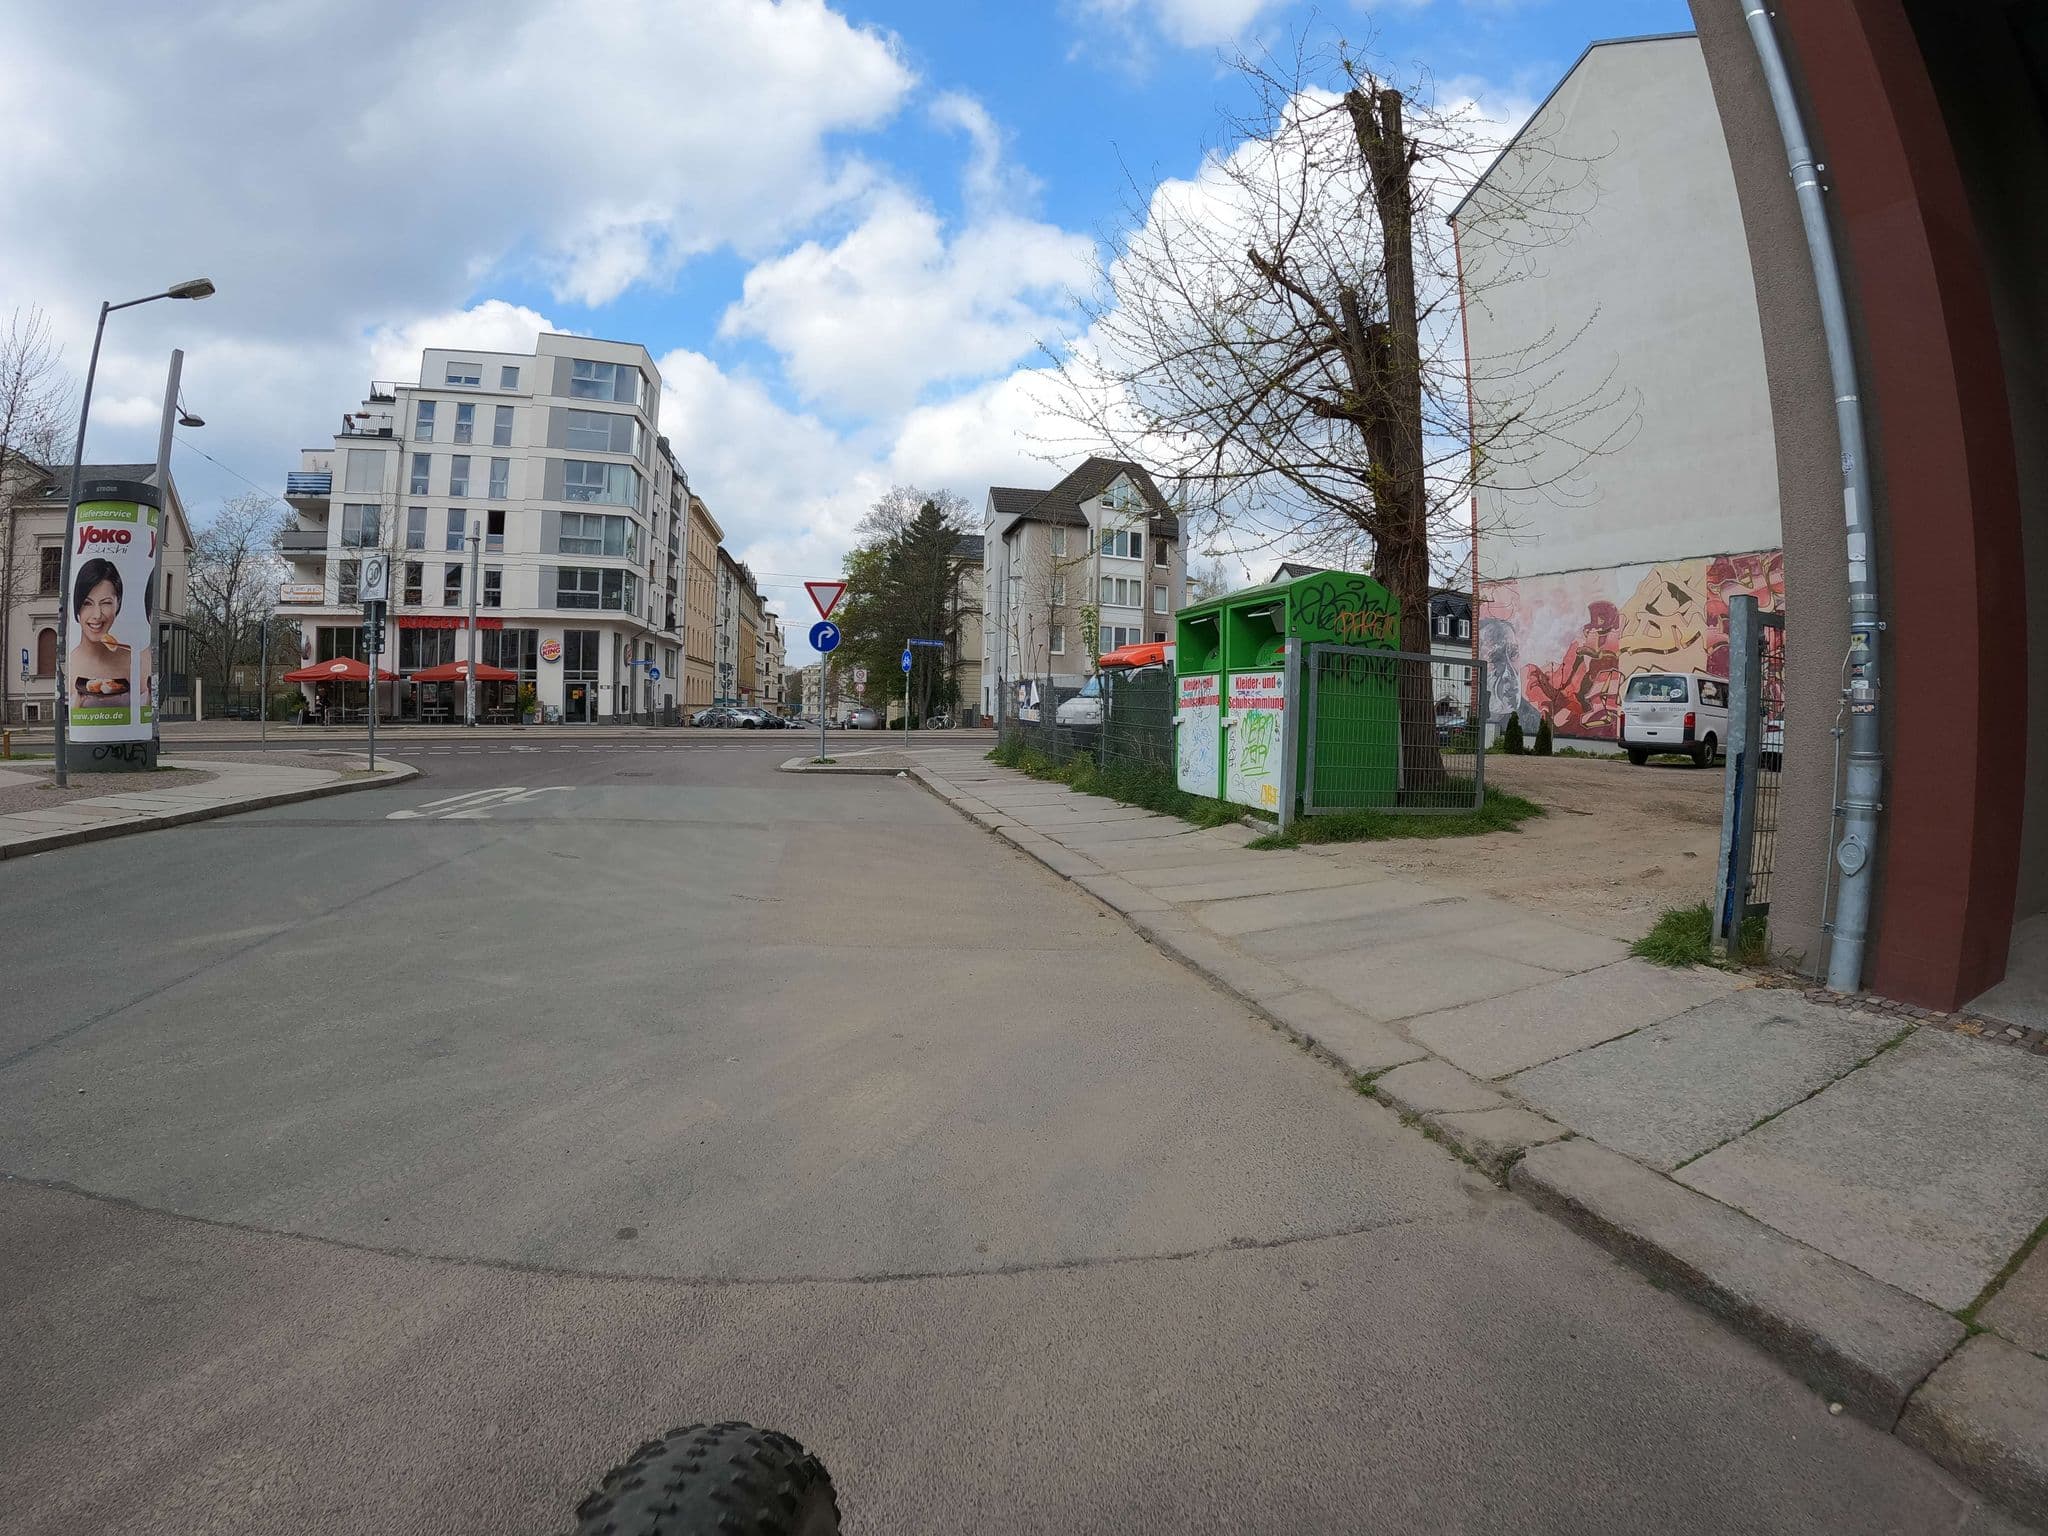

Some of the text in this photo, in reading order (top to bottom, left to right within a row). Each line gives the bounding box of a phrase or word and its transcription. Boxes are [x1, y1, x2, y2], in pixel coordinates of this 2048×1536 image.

[369, 567, 379, 581] 30
[399, 616, 460, 630] BURGER
[542, 643, 561, 651] BURGER
[542, 647, 561, 657] KING
[1236, 675, 1276, 690] Kleider- und
[1228, 696, 1285, 711] Schuhsammlung
